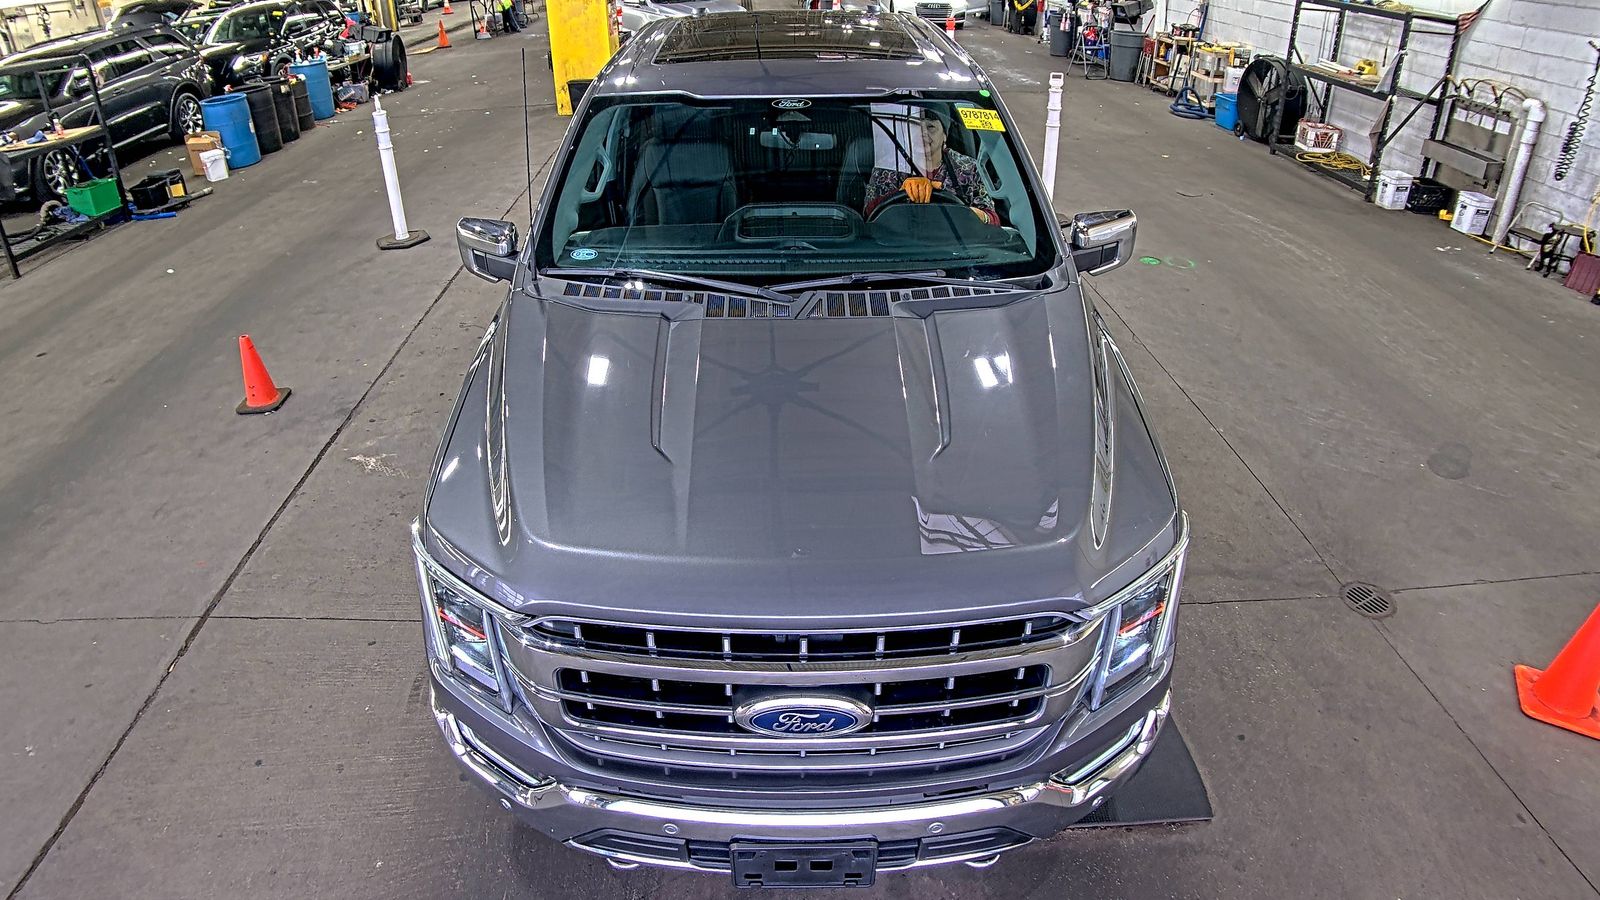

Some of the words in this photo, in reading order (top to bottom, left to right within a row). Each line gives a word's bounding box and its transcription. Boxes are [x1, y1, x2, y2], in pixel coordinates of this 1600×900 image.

[779, 99, 805, 108] Ford
[960, 109, 1001, 121] 9787814
[772, 712, 836, 732] Ford
